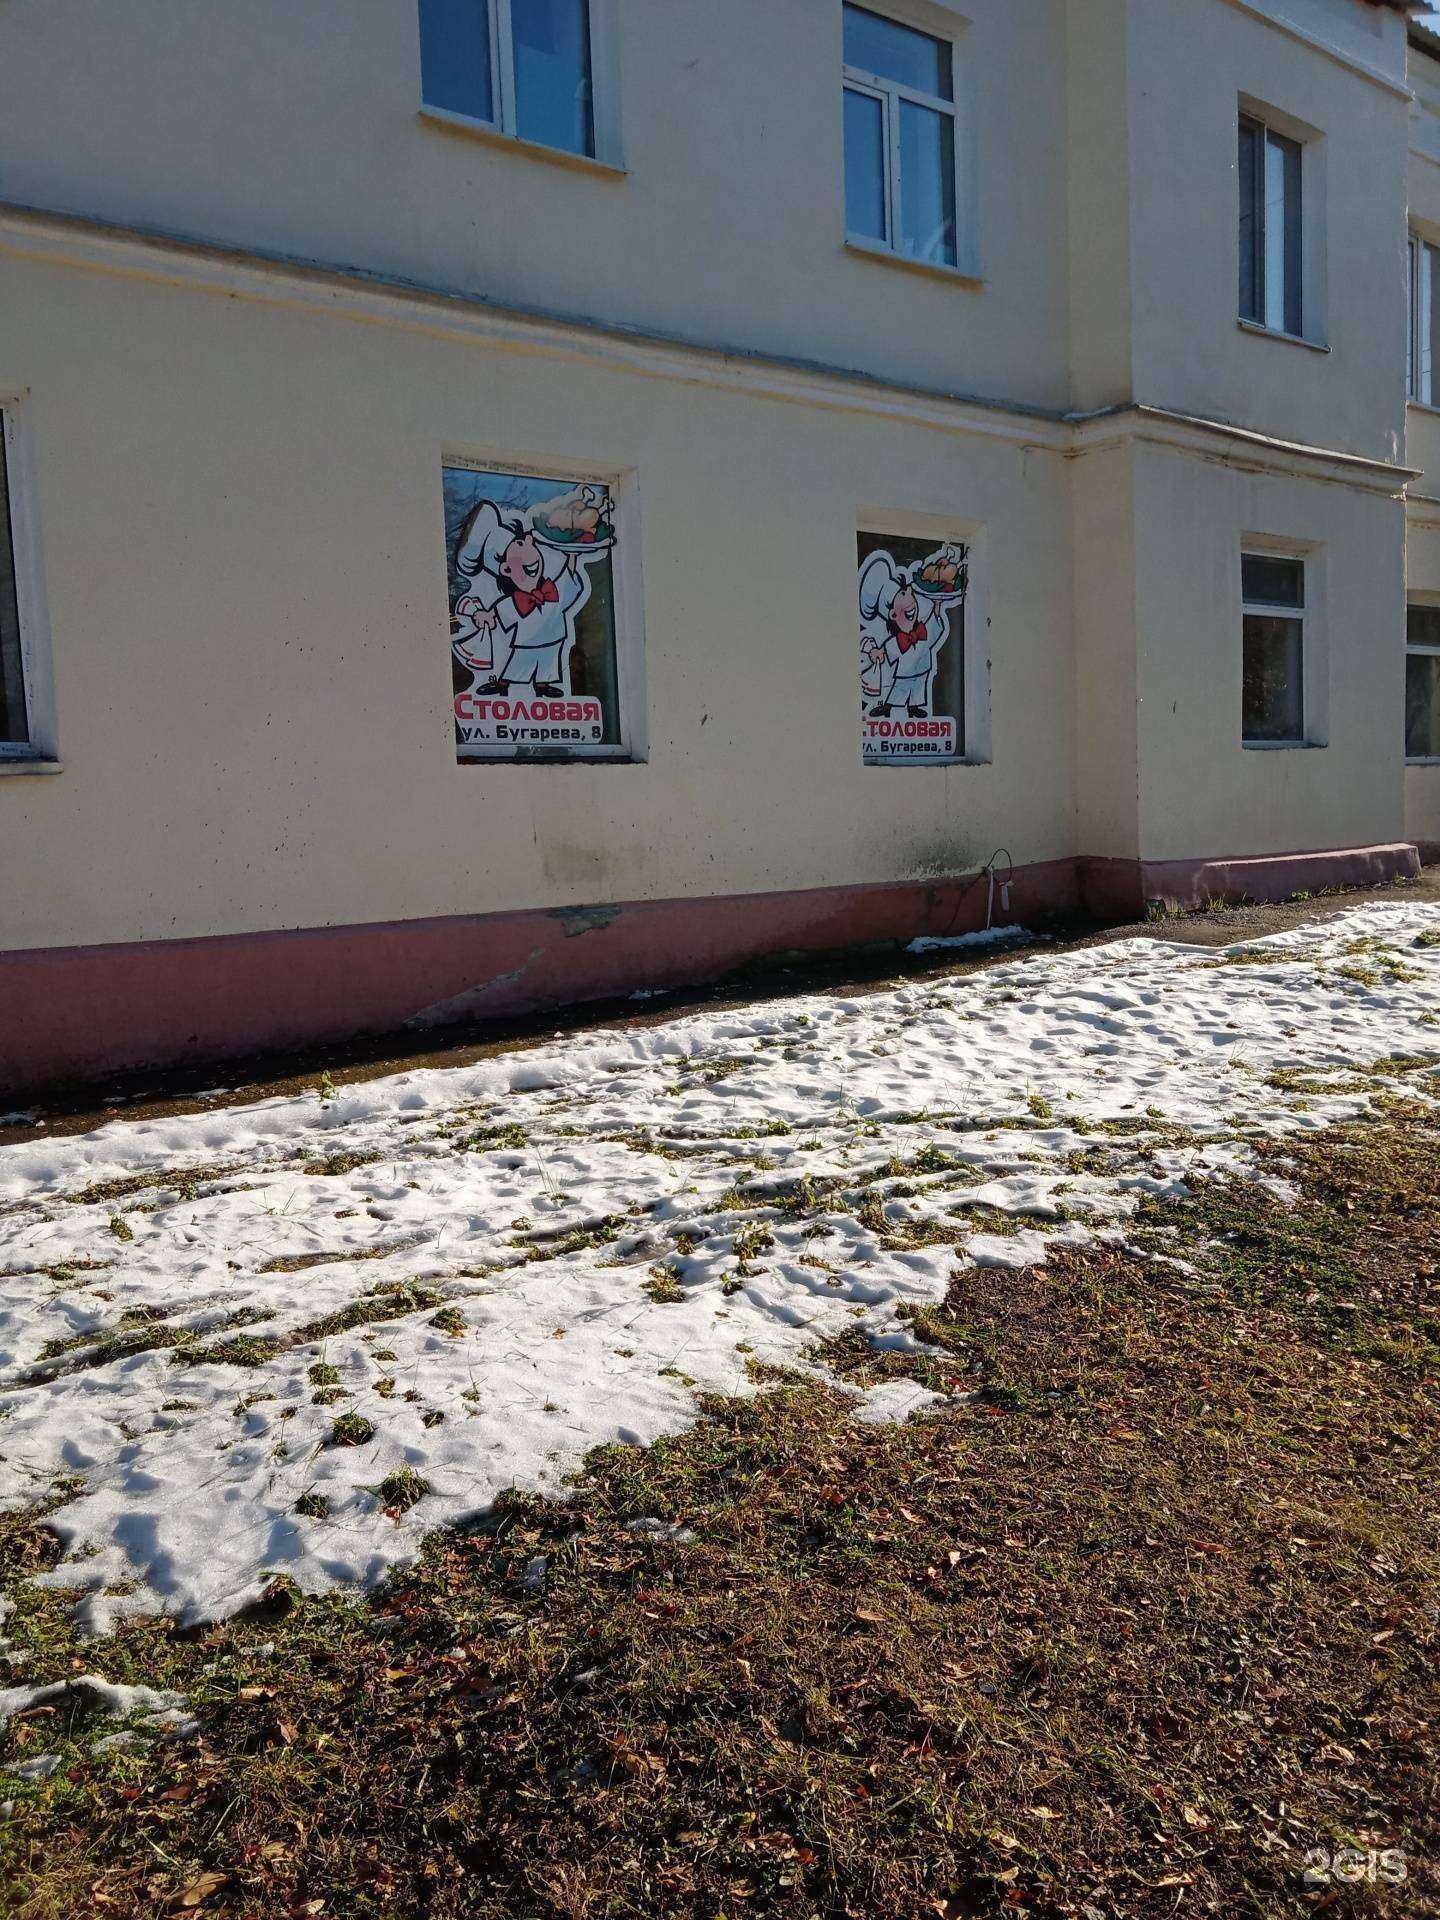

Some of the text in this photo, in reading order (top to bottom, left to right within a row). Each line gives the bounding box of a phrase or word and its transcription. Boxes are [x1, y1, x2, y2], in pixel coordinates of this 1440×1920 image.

[454, 694, 600, 721] Столовая
[462, 725, 601, 741] ул. Бугарева, 8
[862, 717, 951, 737] толовая
[880, 741, 942, 754] Бугарева,
[945, 741, 952, 751] 8
